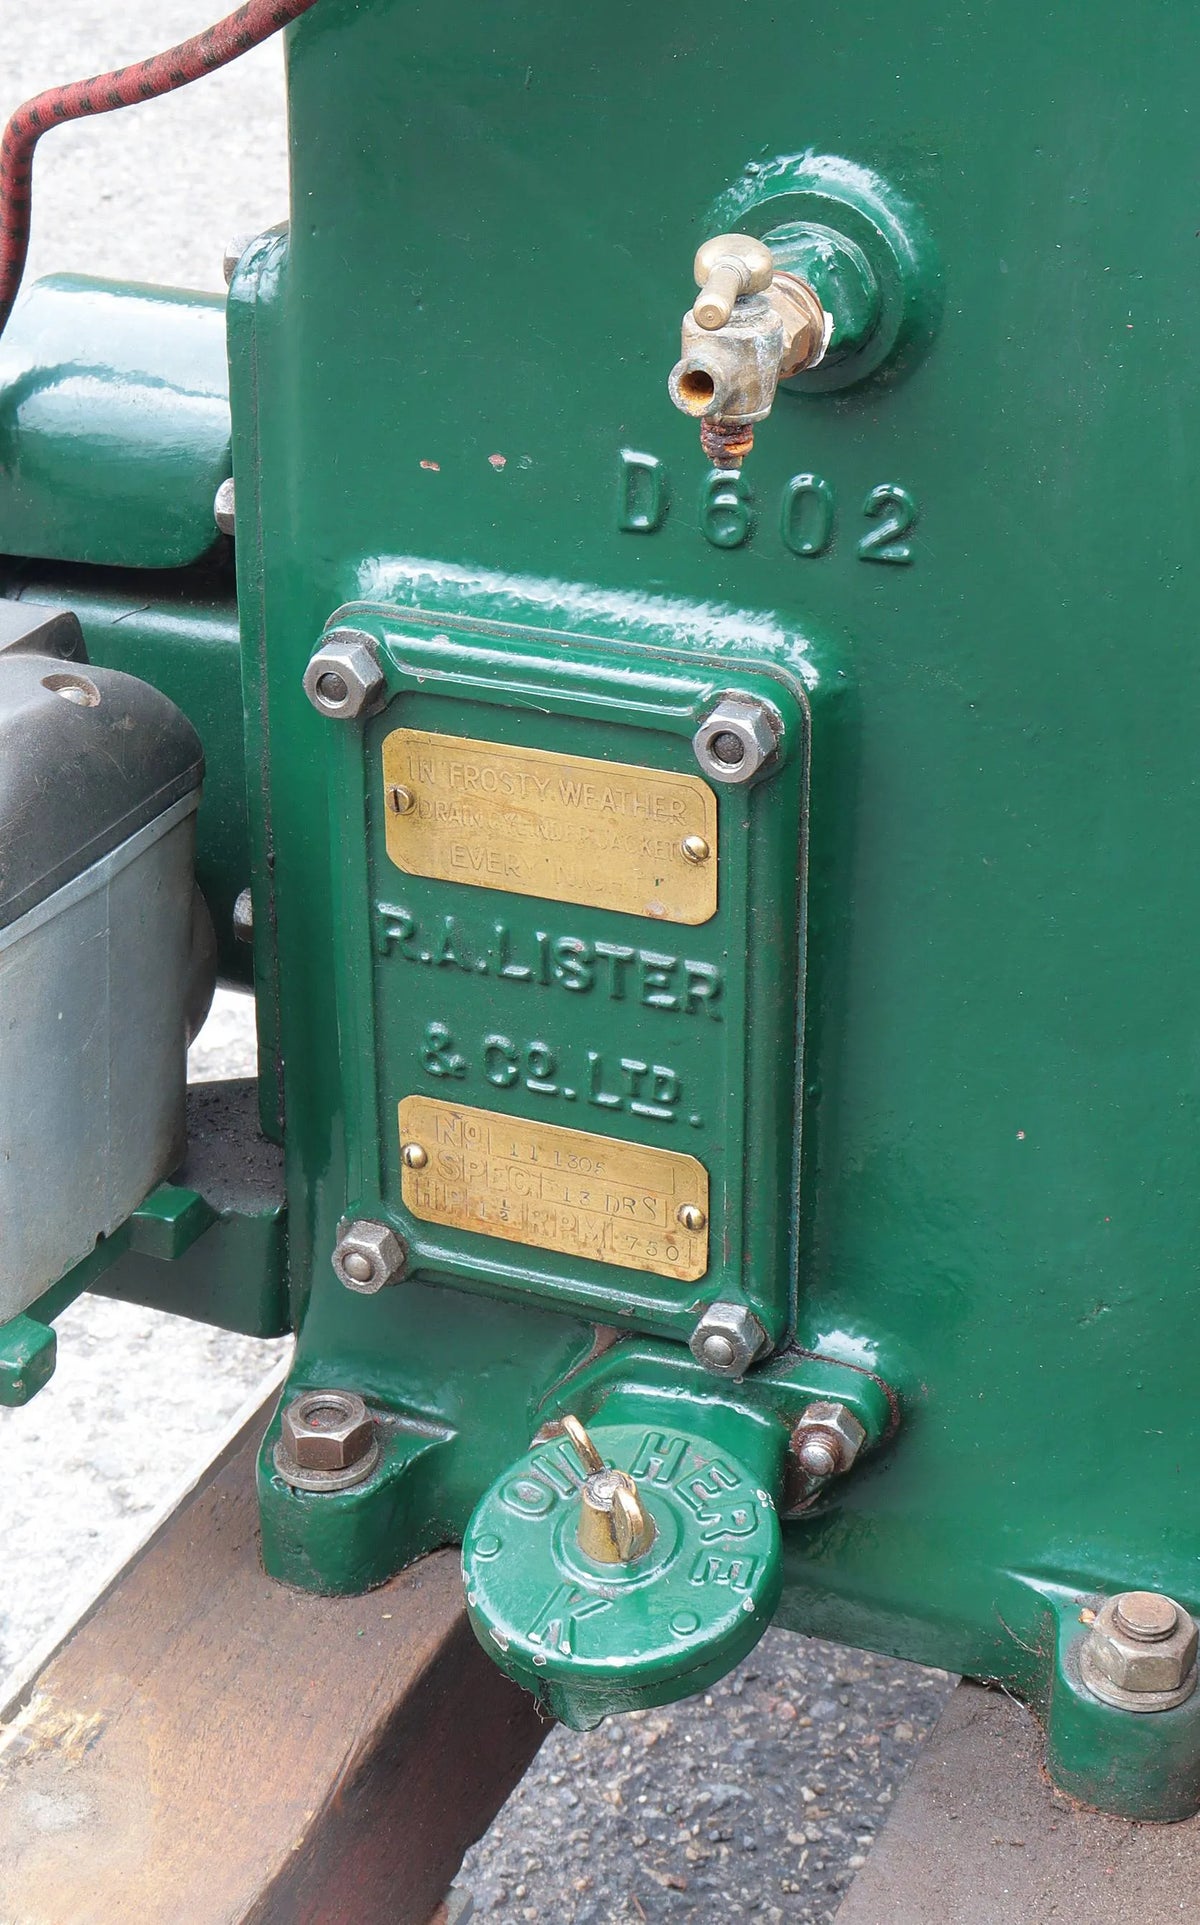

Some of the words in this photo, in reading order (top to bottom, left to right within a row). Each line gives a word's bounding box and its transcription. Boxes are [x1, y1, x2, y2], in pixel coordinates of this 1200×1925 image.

[406, 754, 436, 785] IN
[449, 762, 551, 800] FROSTY
[558, 779, 688, 826] WEATHER
[420, 1020, 467, 1080] &
[630, 1431, 764, 1592] HERE
